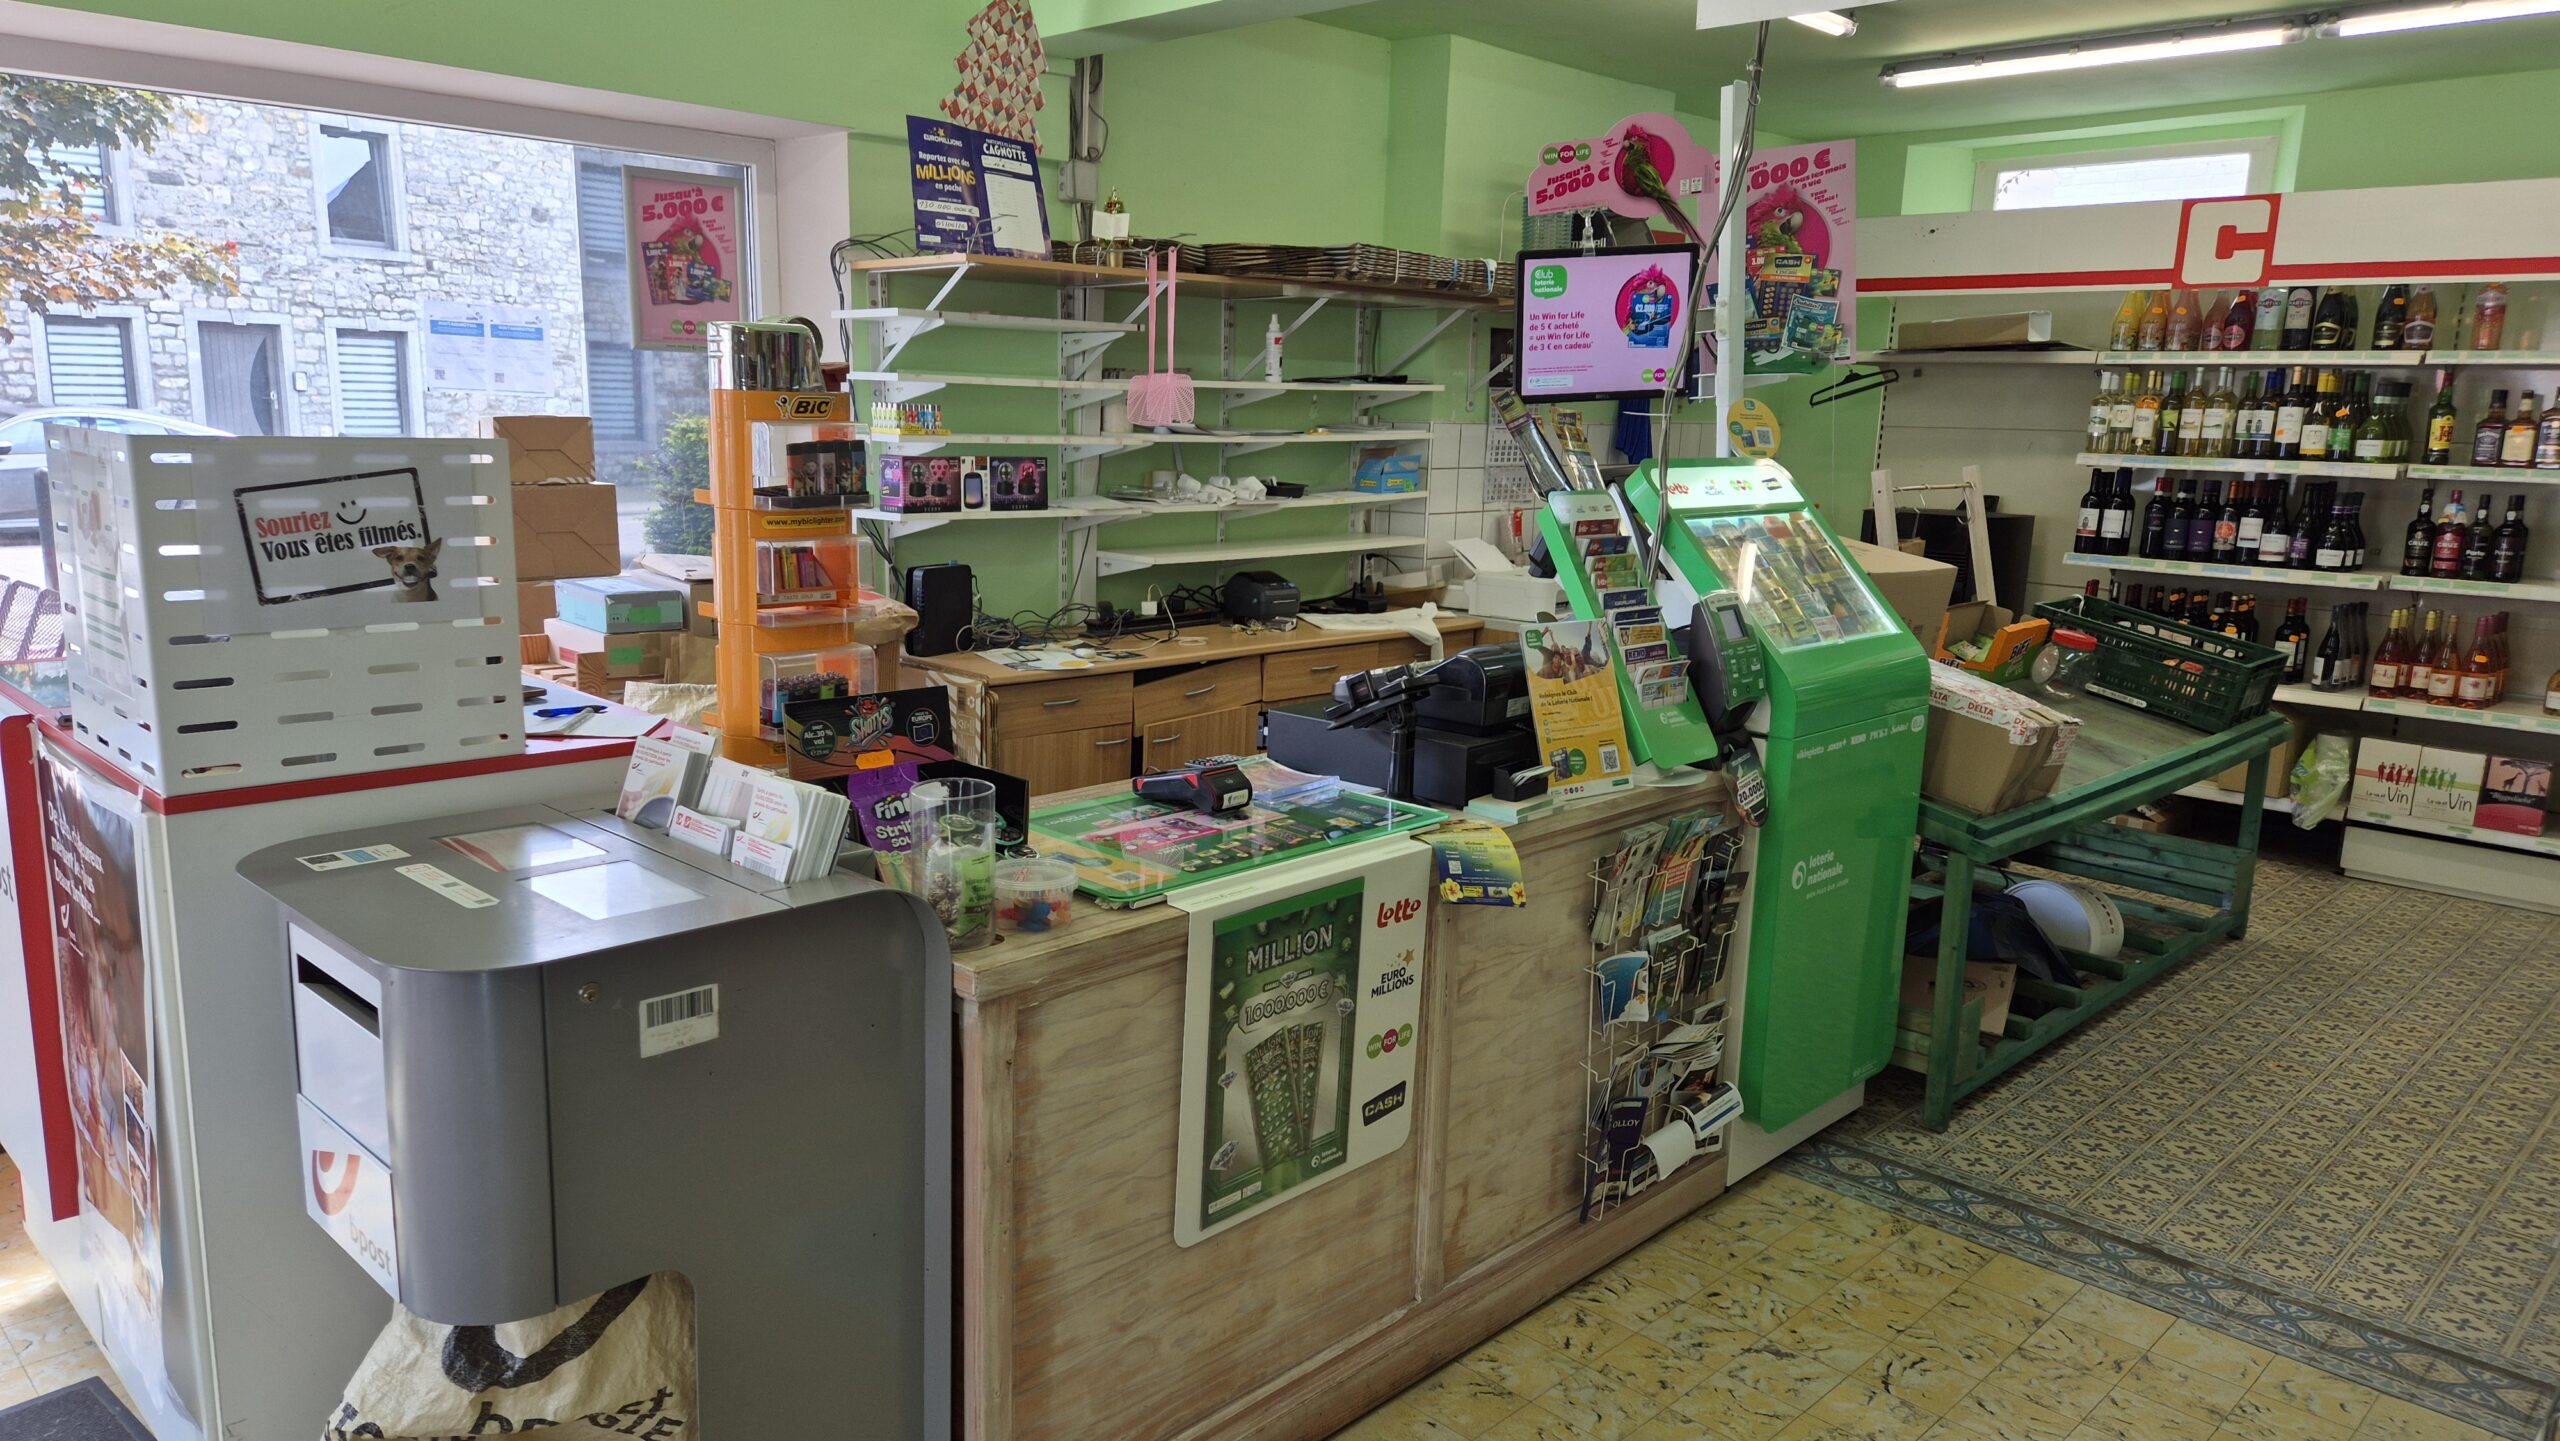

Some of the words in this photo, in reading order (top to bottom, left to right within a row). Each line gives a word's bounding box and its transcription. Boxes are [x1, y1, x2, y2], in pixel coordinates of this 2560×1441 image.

[923, 133, 963, 147] EUROMILLIONS
[982, 142, 1028, 162] CAGNOTTE
[1543, 152, 1558, 160] WIN
[1560, 150, 1574, 158] FOR
[1575, 148, 1590, 157] LIFE
[947, 156, 960, 166] avec
[960, 158, 971, 167] des
[915, 162, 976, 186] MILLIONS
[1546, 163, 1592, 186] Jusqu'à
[1789, 173, 1810, 186] Tous
[1811, 169, 1824, 181] les
[1824, 162, 1847, 177] mois
[935, 182, 944, 190] en
[944, 182, 962, 194] poche
[1536, 172, 1595, 205] 5.000
[1597, 166, 1610, 182] €
[1808, 178, 1822, 188] vie
[654, 187, 703, 204] Jusqu'à
[642, 198, 708, 222] 5.000
[710, 195, 724, 212] €
[1571, 237, 1607, 248] mell
[1775, 258, 1801, 266] CASH
[1534, 285, 1563, 294] nationale
[1529, 313, 1540, 321] Un
[1541, 312, 1556, 321] Win
[1557, 312, 1568, 320] for
[1570, 311, 1585, 319] Life
[1529, 323, 1539, 331] de
[1547, 322, 1553, 330] €
[1554, 321, 1579, 330] acheté
[1548, 332, 1562, 340] Win
[1576, 331, 1590, 339] Life
[1528, 343, 1538, 351] de
[1668, 483, 1689, 495] otto
[255, 511, 332, 539] Souriez
[260, 539, 310, 563] Vous
[315, 532, 355, 554] êtes
[358, 520, 422, 548] filmés.
[1626, 648, 1646, 659] KENO
[1929, 689, 1950, 702] ELTA
[1967, 701, 1994, 717] DELTA
[911, 714, 933, 723] EUROPE
[813, 738, 825, 746] vol
[2387, 786, 2409, 805] Vin
[2448, 792, 2472, 812] Vin
[1809, 849, 1835, 869] loterie
[1807, 861, 1844, 886] nationale
[1246, 923, 1334, 977] MILLION
[1380, 966, 1407, 985] EURO
[1318, 979, 1329, 999] €
[1371, 974, 1415, 999] MILLIONS
[1366, 1041, 1382, 1053] WIN
[1383, 1035, 1397, 1047] FOR
[1398, 1028, 1412, 1041] LIFE
[1364, 1092, 1404, 1118] CASH
[1612, 1119, 1640, 1129] OLLOY
[1320, 1152, 1343, 1164] nationale
[348, 1213, 392, 1277] bpost
